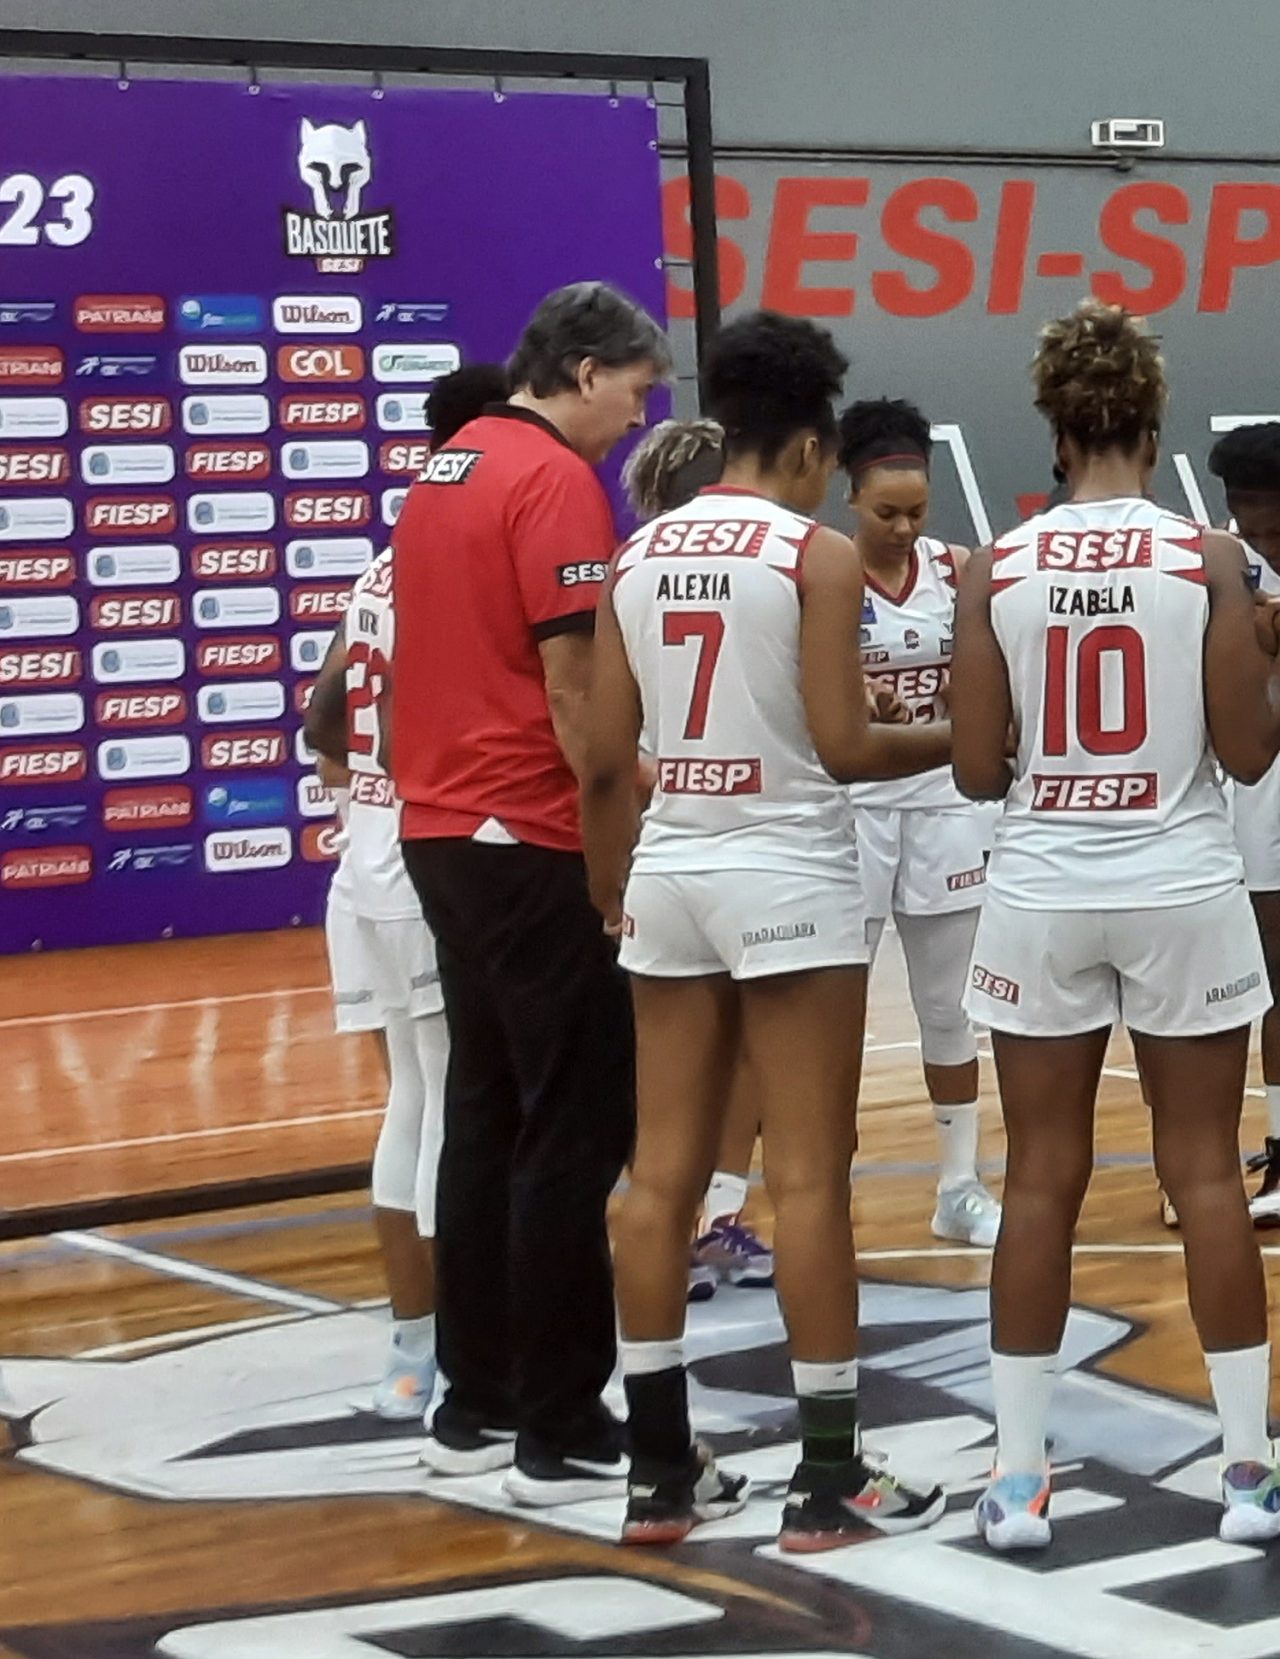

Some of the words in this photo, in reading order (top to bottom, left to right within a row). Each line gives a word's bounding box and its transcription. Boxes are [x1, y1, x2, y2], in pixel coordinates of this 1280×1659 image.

[0, 174, 95, 246] 23
[286, 211, 391, 254] BASQUETE
[290, 350, 352, 376] GOL
[89, 403, 164, 429] SESI
[287, 403, 360, 425] FIESP
[192, 451, 264, 472] FIESP
[418, 452, 480, 482] SESI
[92, 503, 170, 526] FIESP
[291, 496, 364, 523] SESI
[652, 522, 758, 553] SESI
[1046, 531, 1143, 568] SESI
[200, 548, 270, 575] SESI
[657, 573, 731, 600] ALEXIA
[1050, 585, 1135, 616] IZABELA
[99, 599, 174, 627] SESI
[0, 652, 75, 682] SESI
[202, 643, 274, 667] FIESP
[662, 611, 725, 740] 7
[1042, 625, 1147, 757] 10
[102, 695, 181, 722] FIESP
[0, 751, 81, 778] FIESP
[209, 736, 282, 766] SESI
[660, 762, 752, 791] FIESP
[1035, 777, 1148, 808] FIESP
[973, 967, 1015, 1000] SESI
